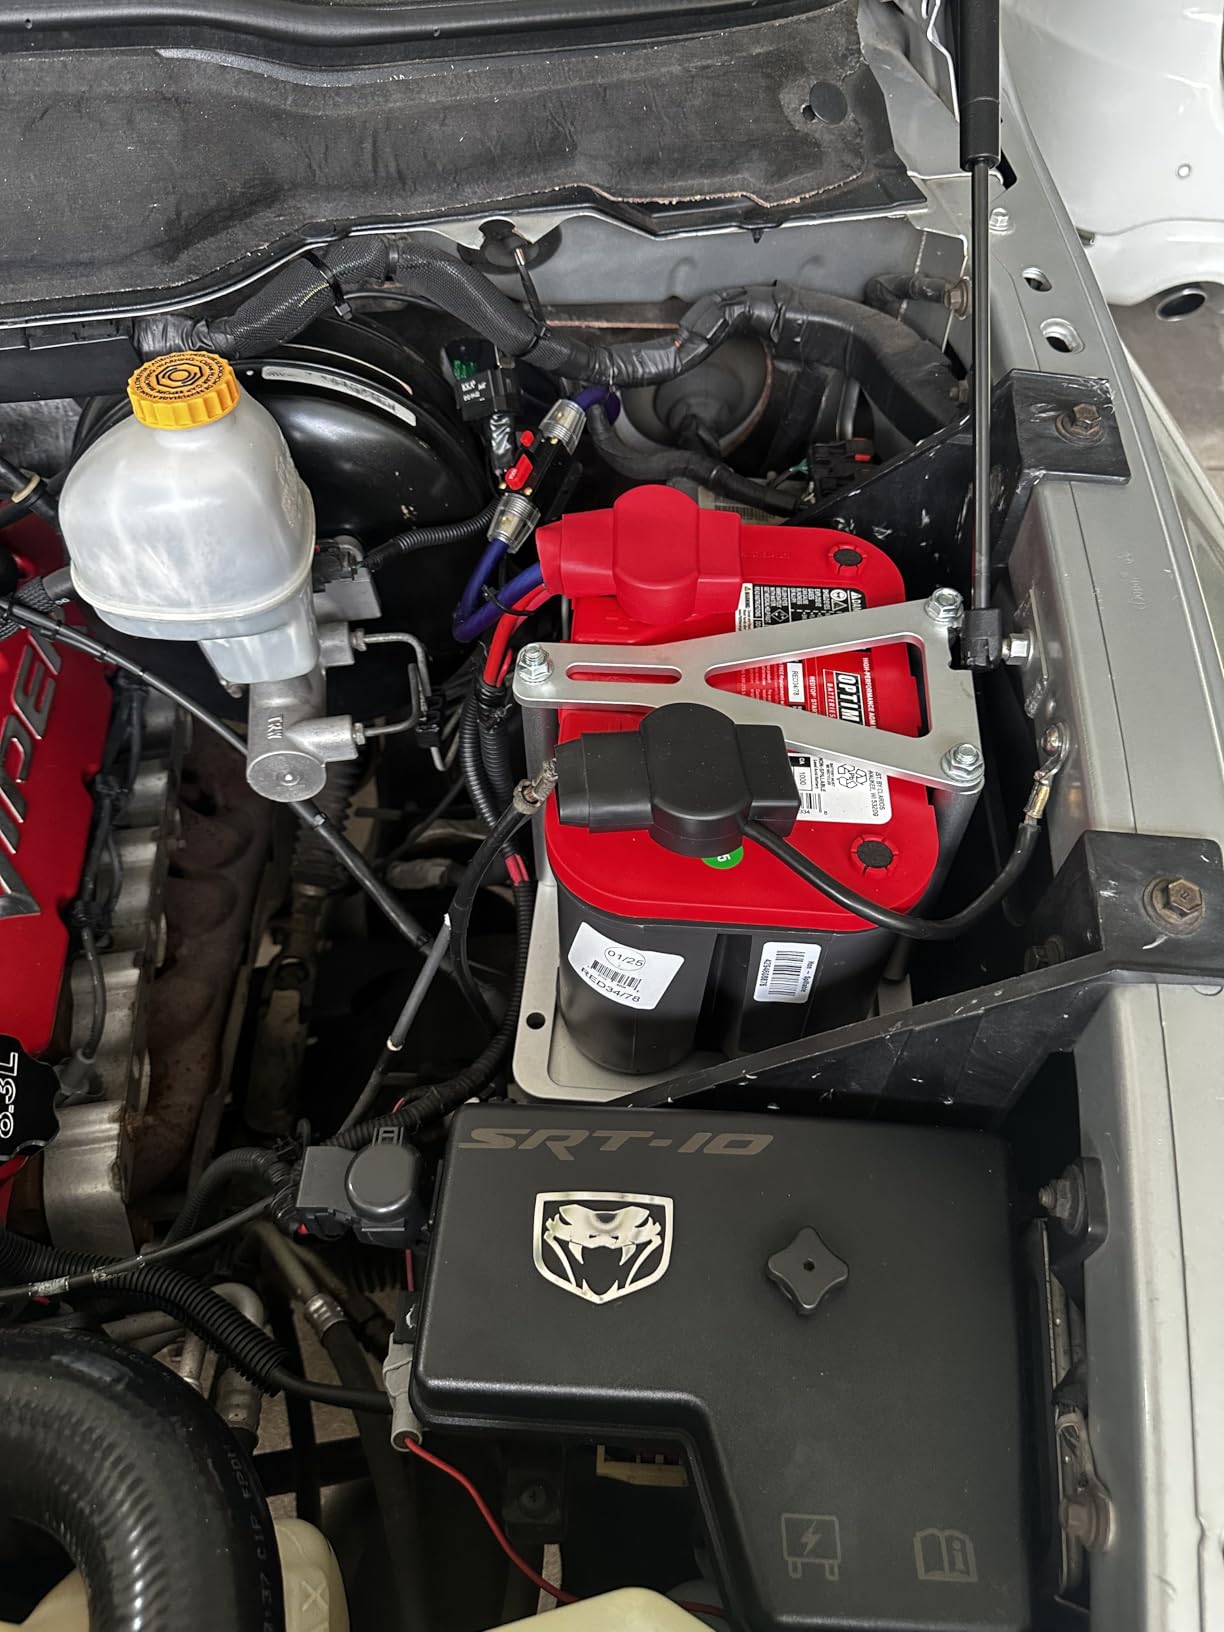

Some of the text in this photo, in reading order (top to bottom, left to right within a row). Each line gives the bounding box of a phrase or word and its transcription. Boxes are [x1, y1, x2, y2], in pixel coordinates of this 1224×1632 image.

[826, 683, 836, 718] BATTERIES
[837, 674, 860, 722] OPTIM
[862, 657, 875, 712] HIGH-PERFORMANCE
[818, 757, 826, 792] NON-SPILLABLE
[848, 772, 855, 780] Pb
[871, 799, 879, 817] 53209
[607, 949, 643, 967] 01/25
[581, 966, 641, 1003] RED34/78
[458, 1127, 774, 1161] SRT-10
